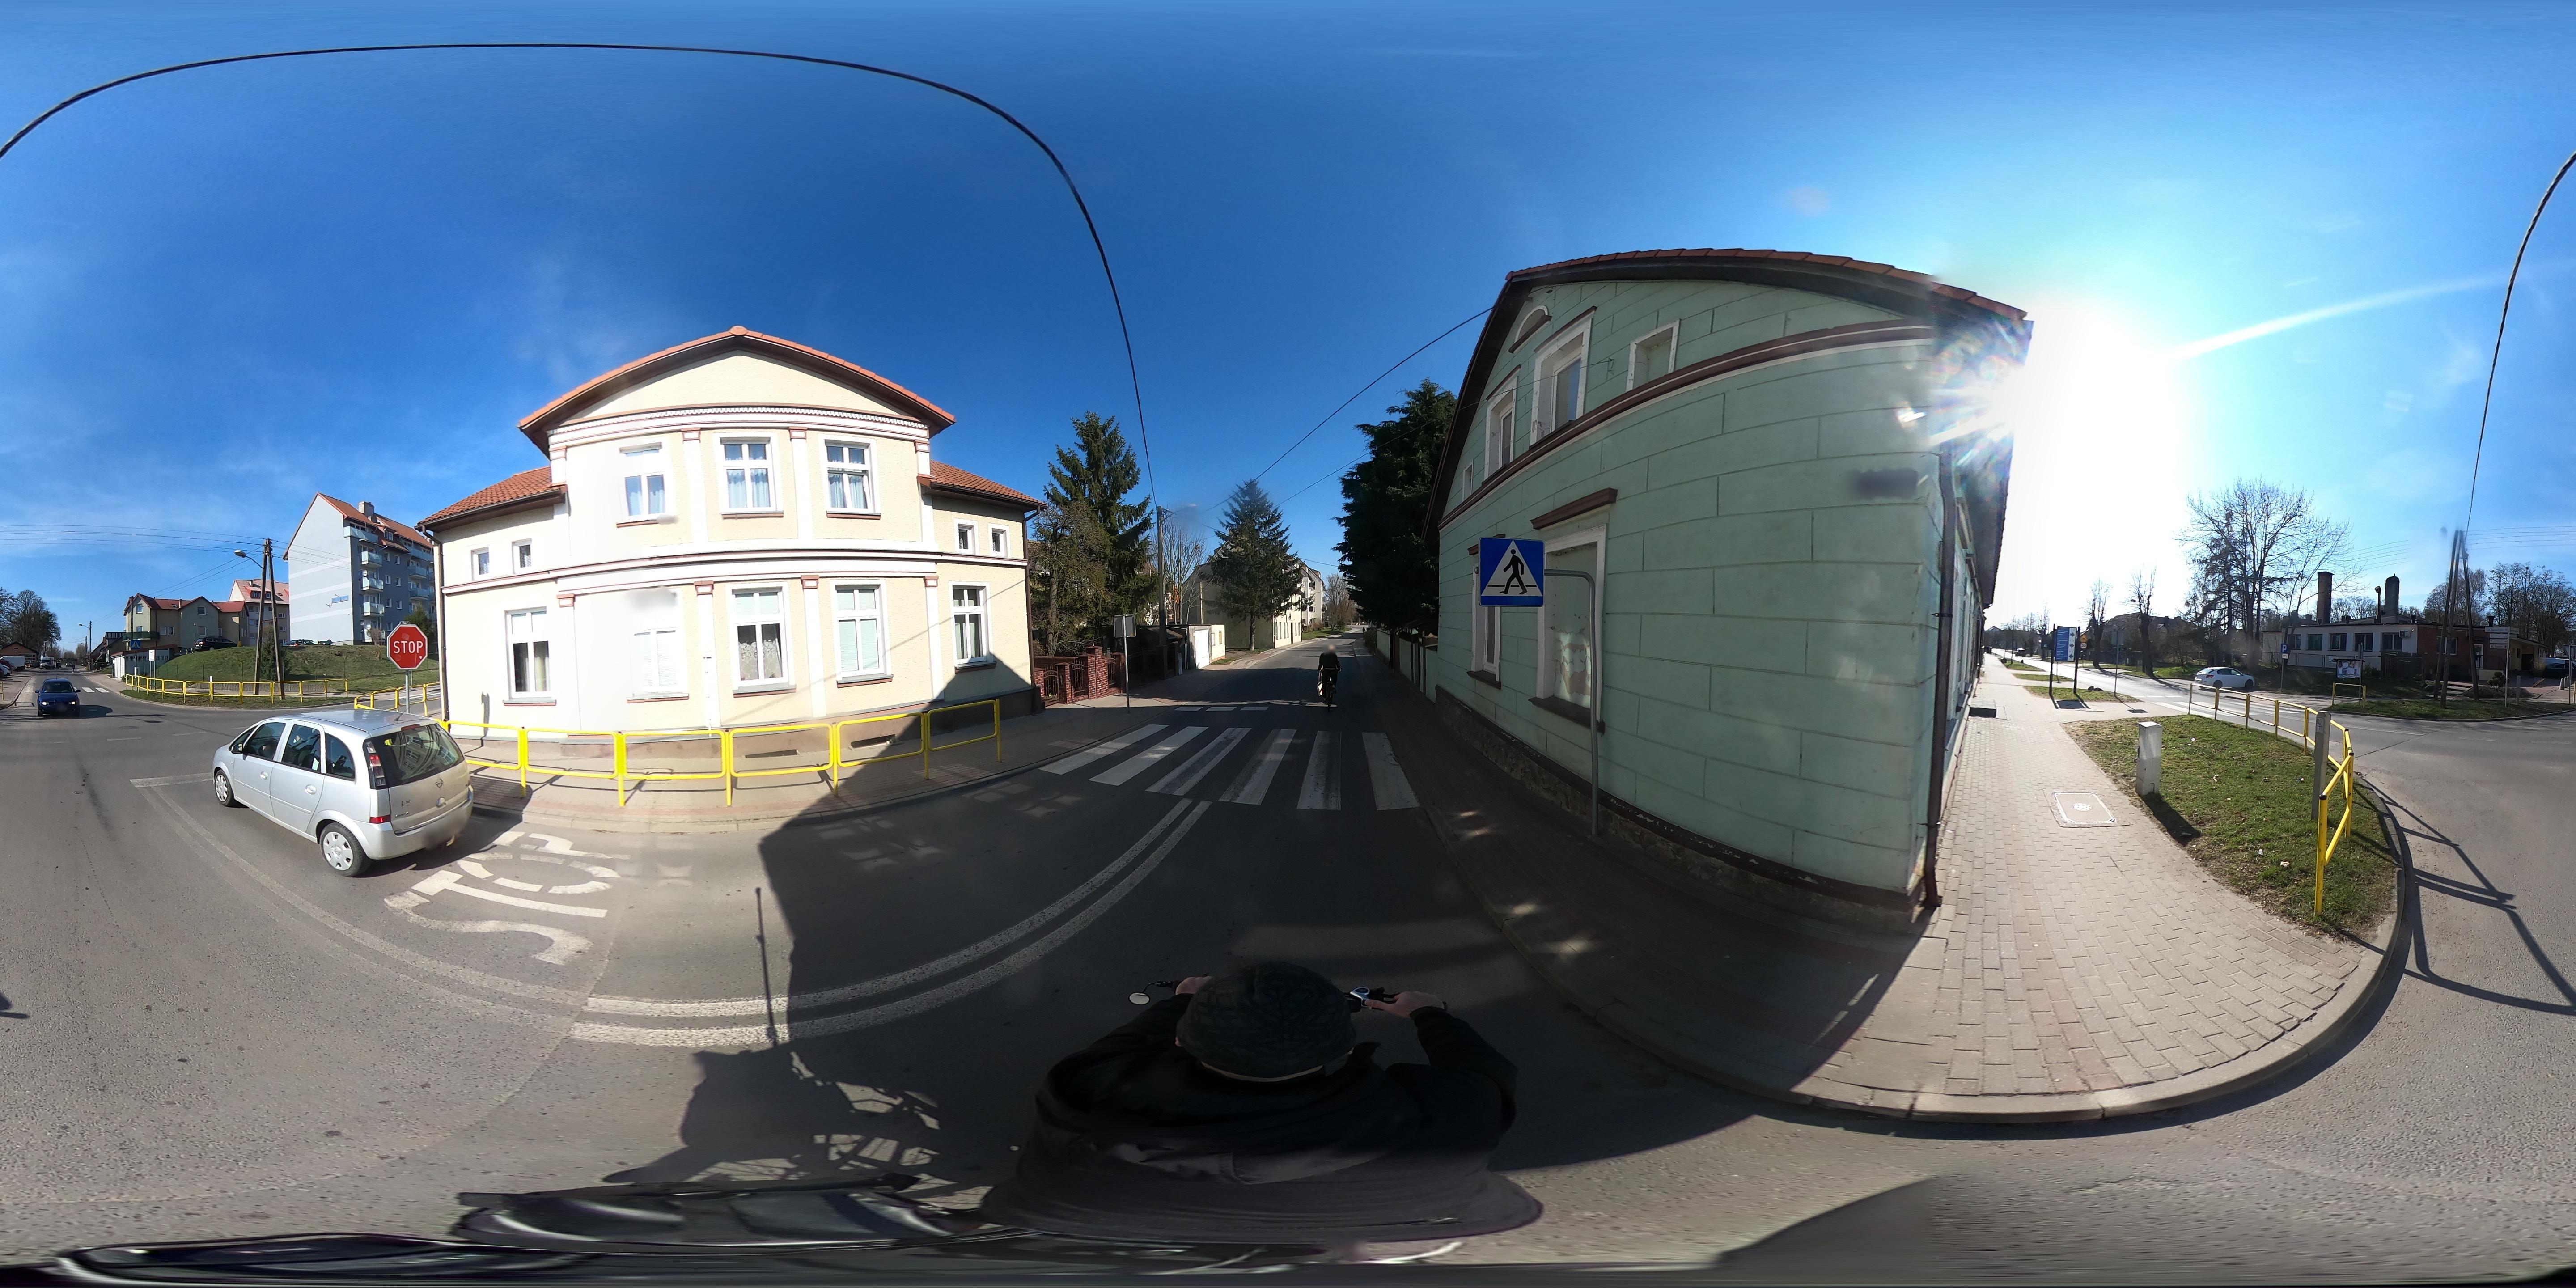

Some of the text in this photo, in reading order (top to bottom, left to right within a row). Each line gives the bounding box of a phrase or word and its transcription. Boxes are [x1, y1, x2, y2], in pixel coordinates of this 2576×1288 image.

[394, 641, 423, 654] STOP
[2282, 644, 2287, 652] P
[384, 831, 631, 966] STOP
